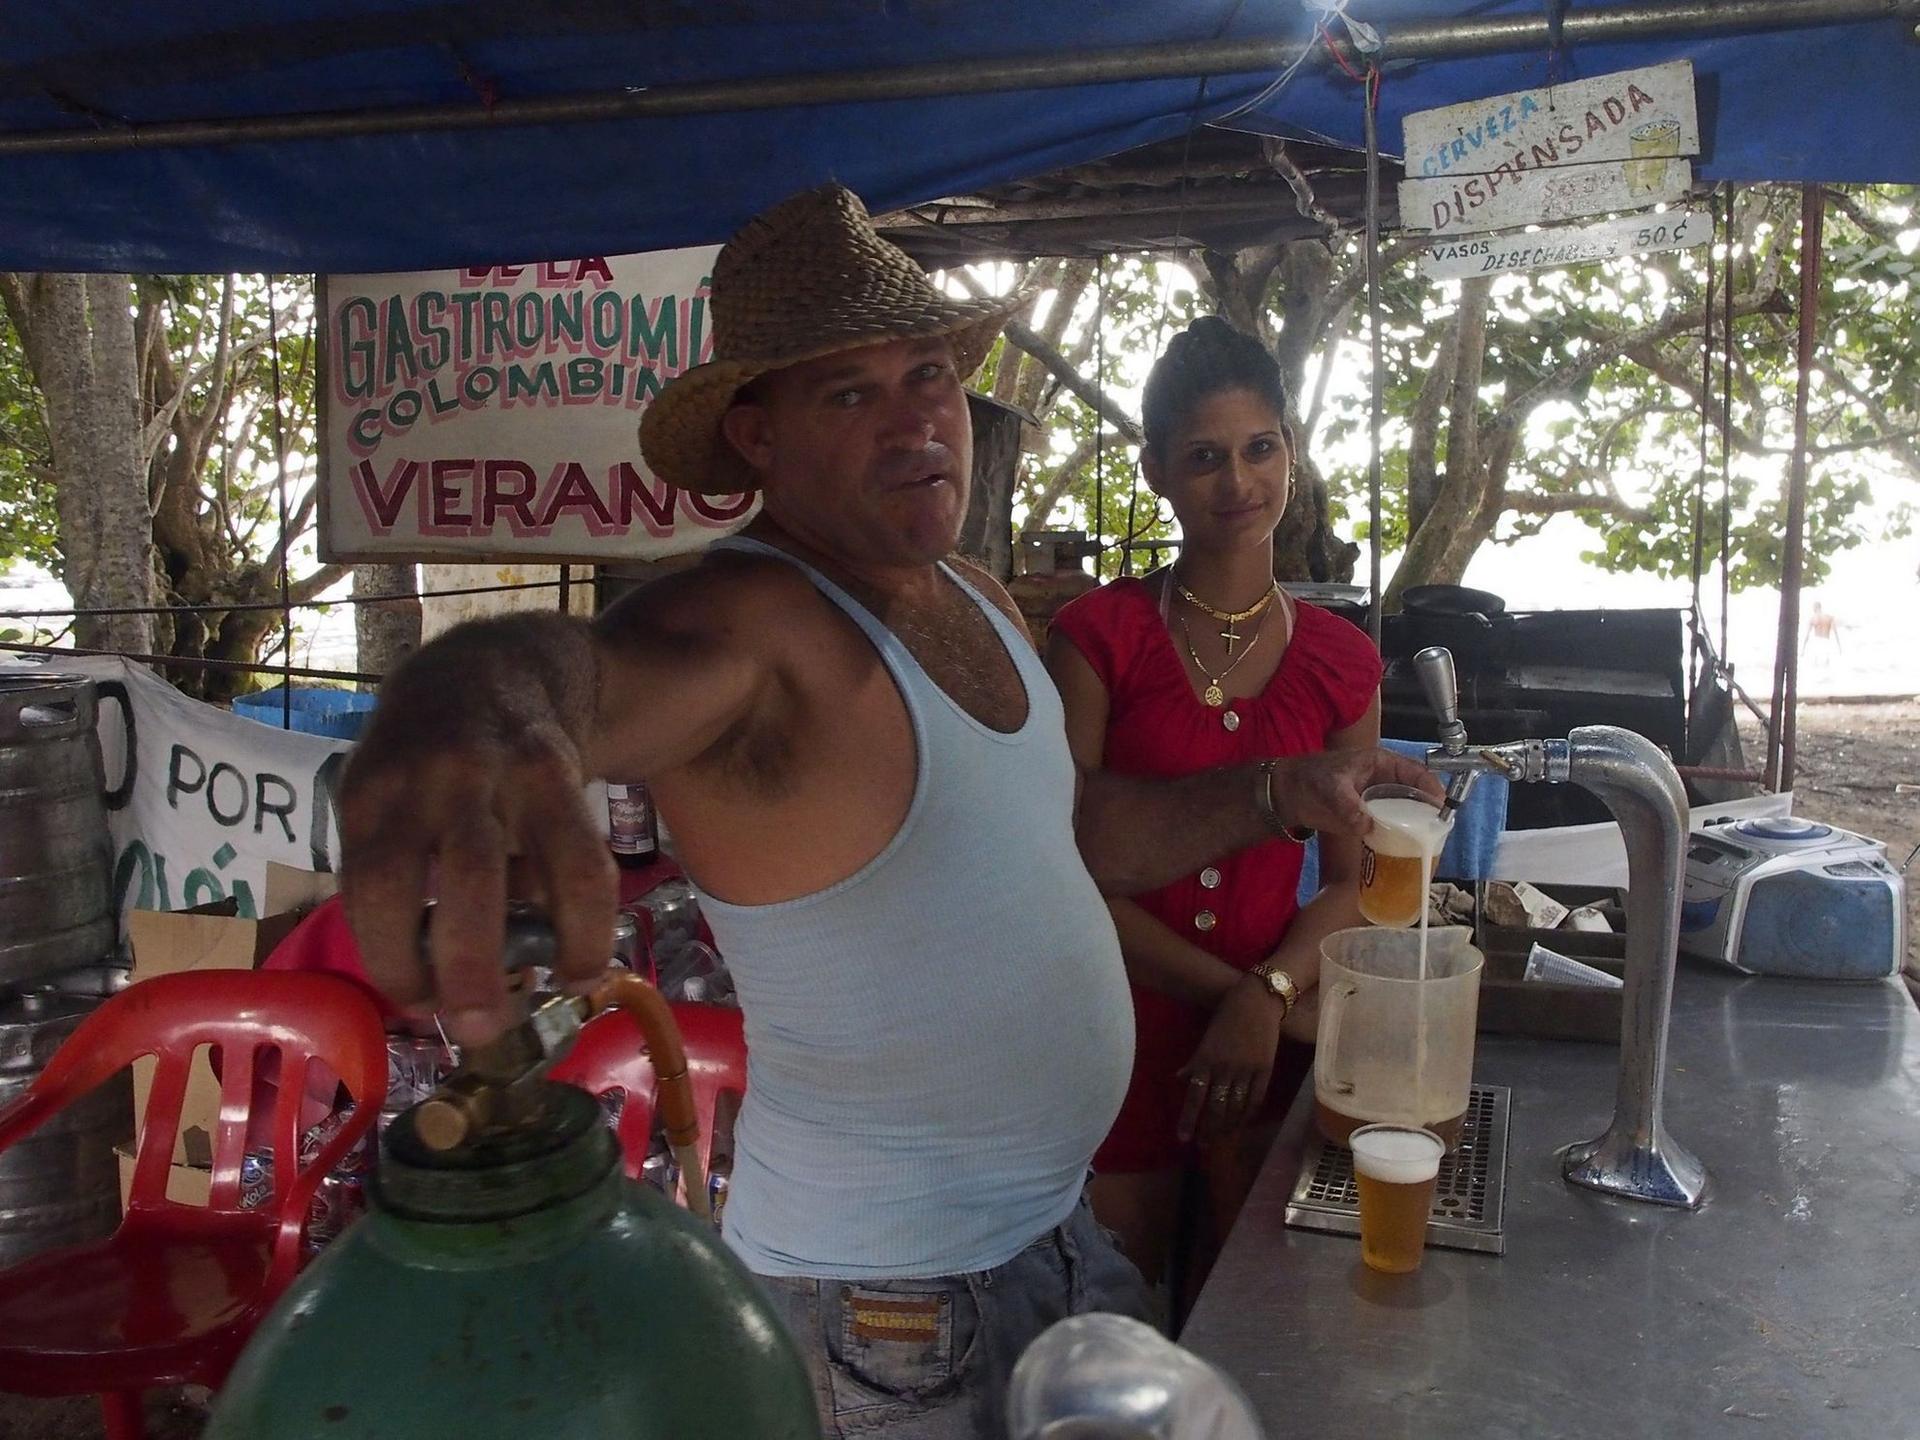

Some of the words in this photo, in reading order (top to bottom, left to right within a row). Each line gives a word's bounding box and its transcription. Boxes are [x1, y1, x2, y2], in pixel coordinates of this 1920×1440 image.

[1421, 95, 1539, 178] CERVEZA
[1432, 84, 1654, 232] DISPENSADA
[1432, 240, 1490, 262] VASOS
[336, 276, 716, 402] GASTRONOMÍ
[167, 743, 297, 843] POR
